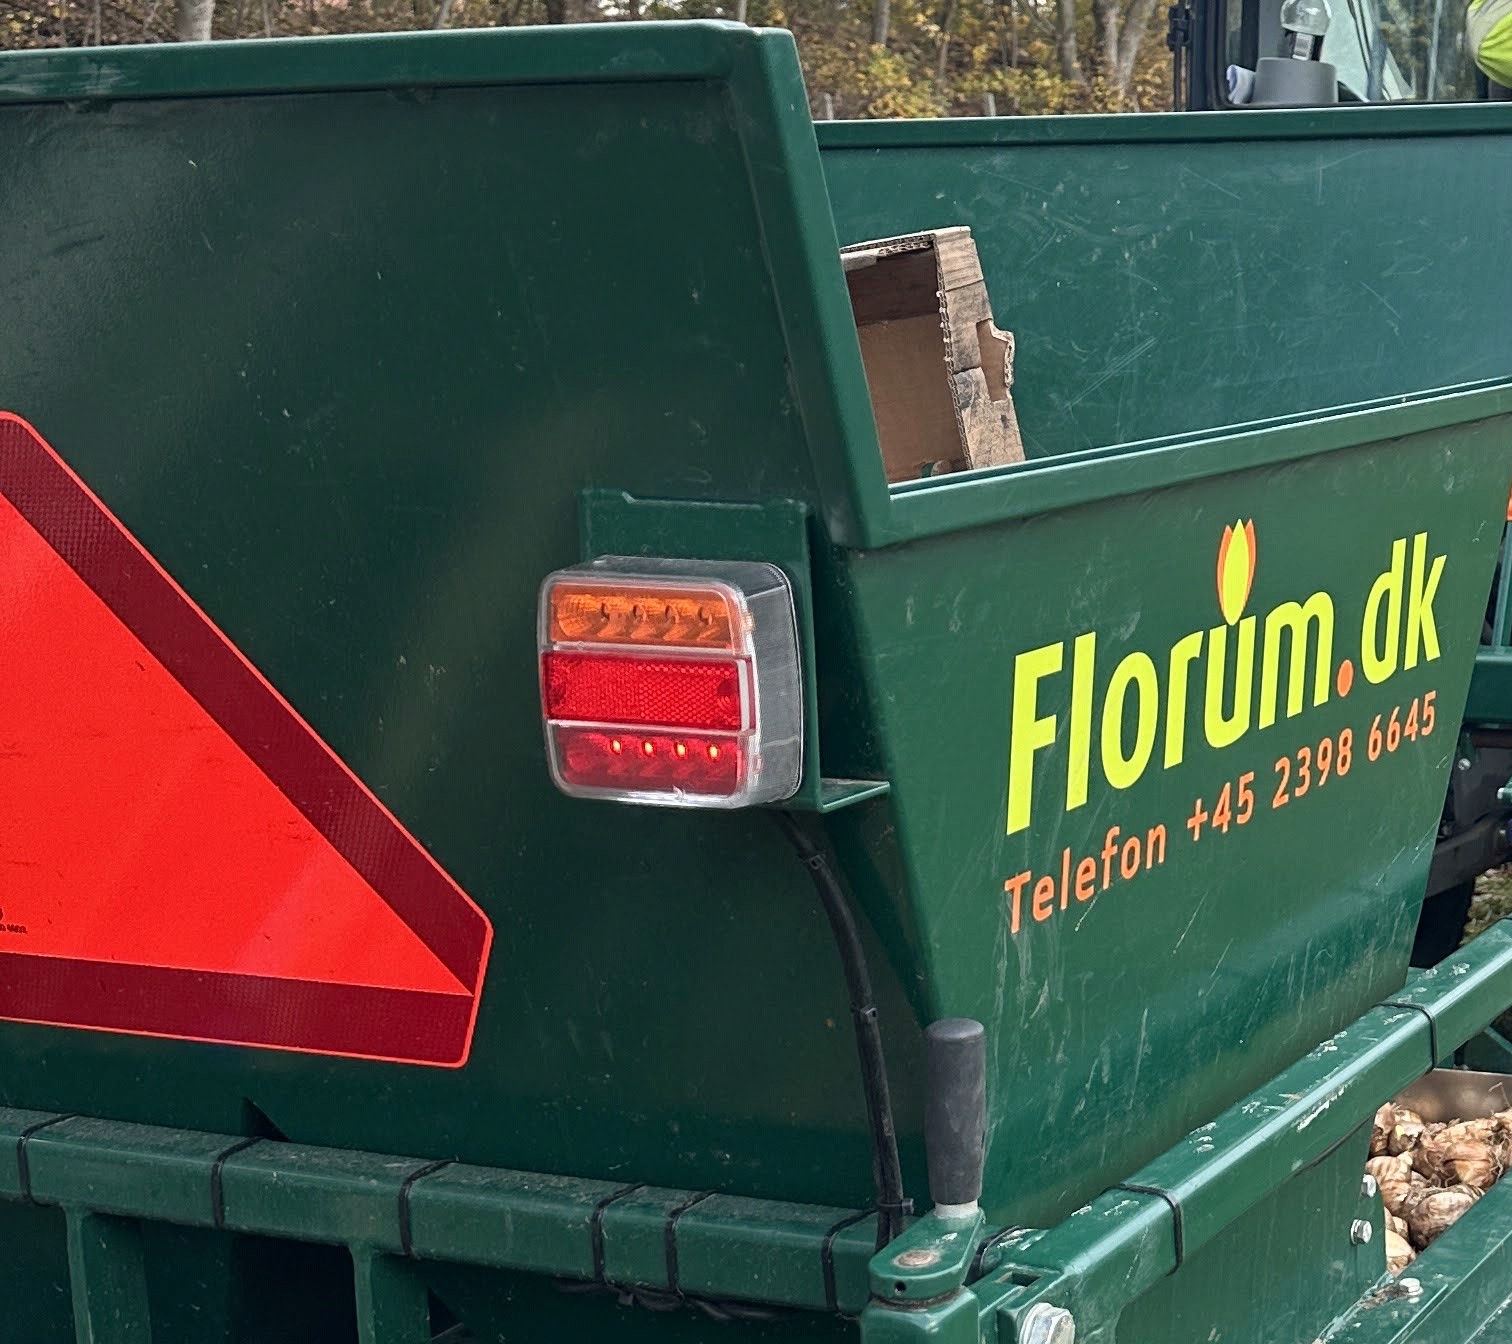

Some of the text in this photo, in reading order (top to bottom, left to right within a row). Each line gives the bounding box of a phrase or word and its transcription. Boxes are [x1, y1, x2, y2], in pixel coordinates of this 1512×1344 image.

[1004, 690, 1437, 934] Telefon +45 2398 6645
[1006, 532, 1447, 835] Florum.dk
